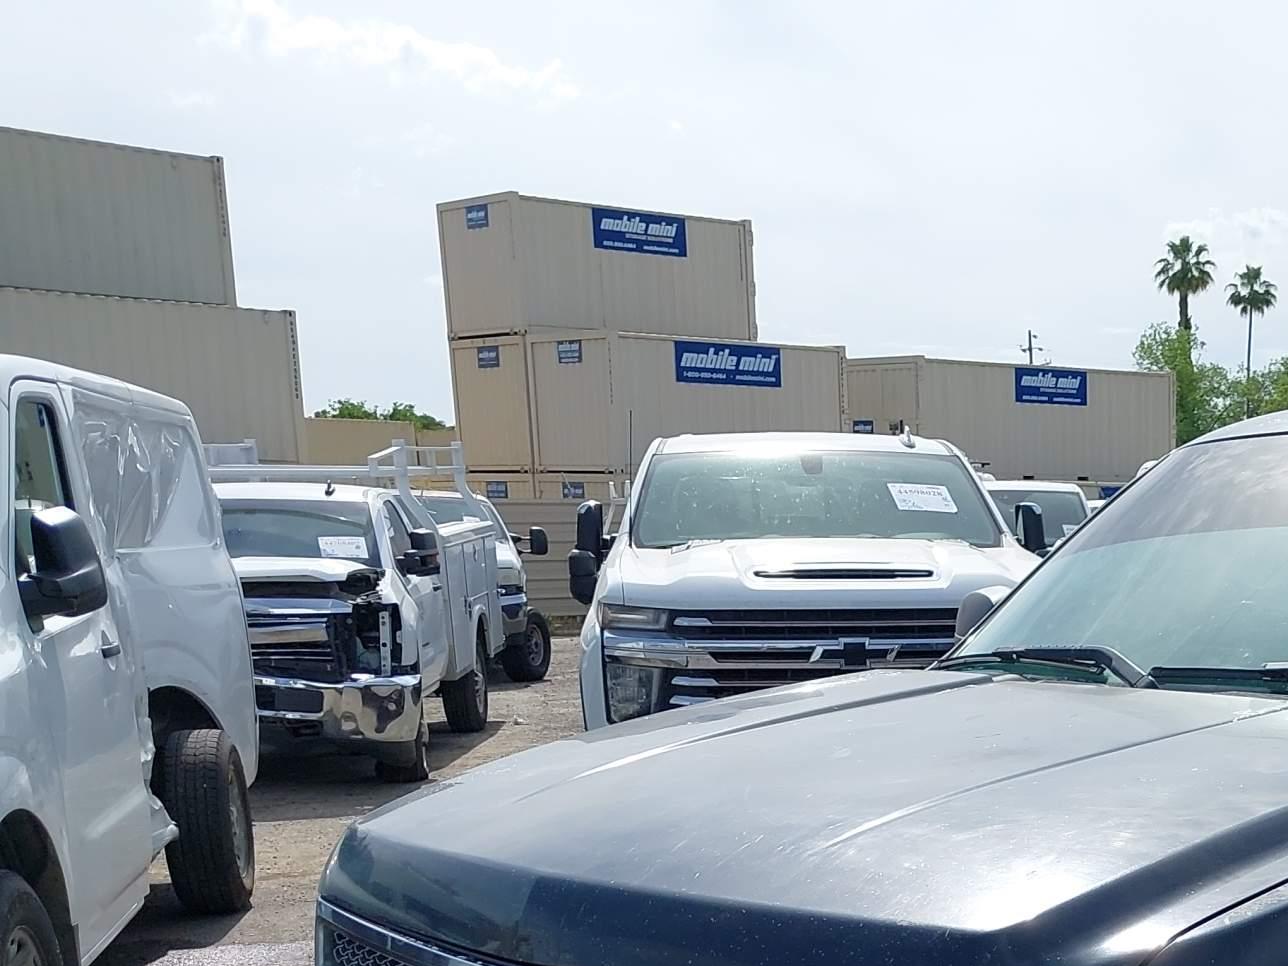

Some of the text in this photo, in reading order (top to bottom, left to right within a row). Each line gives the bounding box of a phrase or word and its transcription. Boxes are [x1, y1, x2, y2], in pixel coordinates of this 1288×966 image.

[600, 215, 678, 237] mobile mini
[680, 347, 779, 372] mobile mini
[1020, 372, 1081, 389] mobile mini
